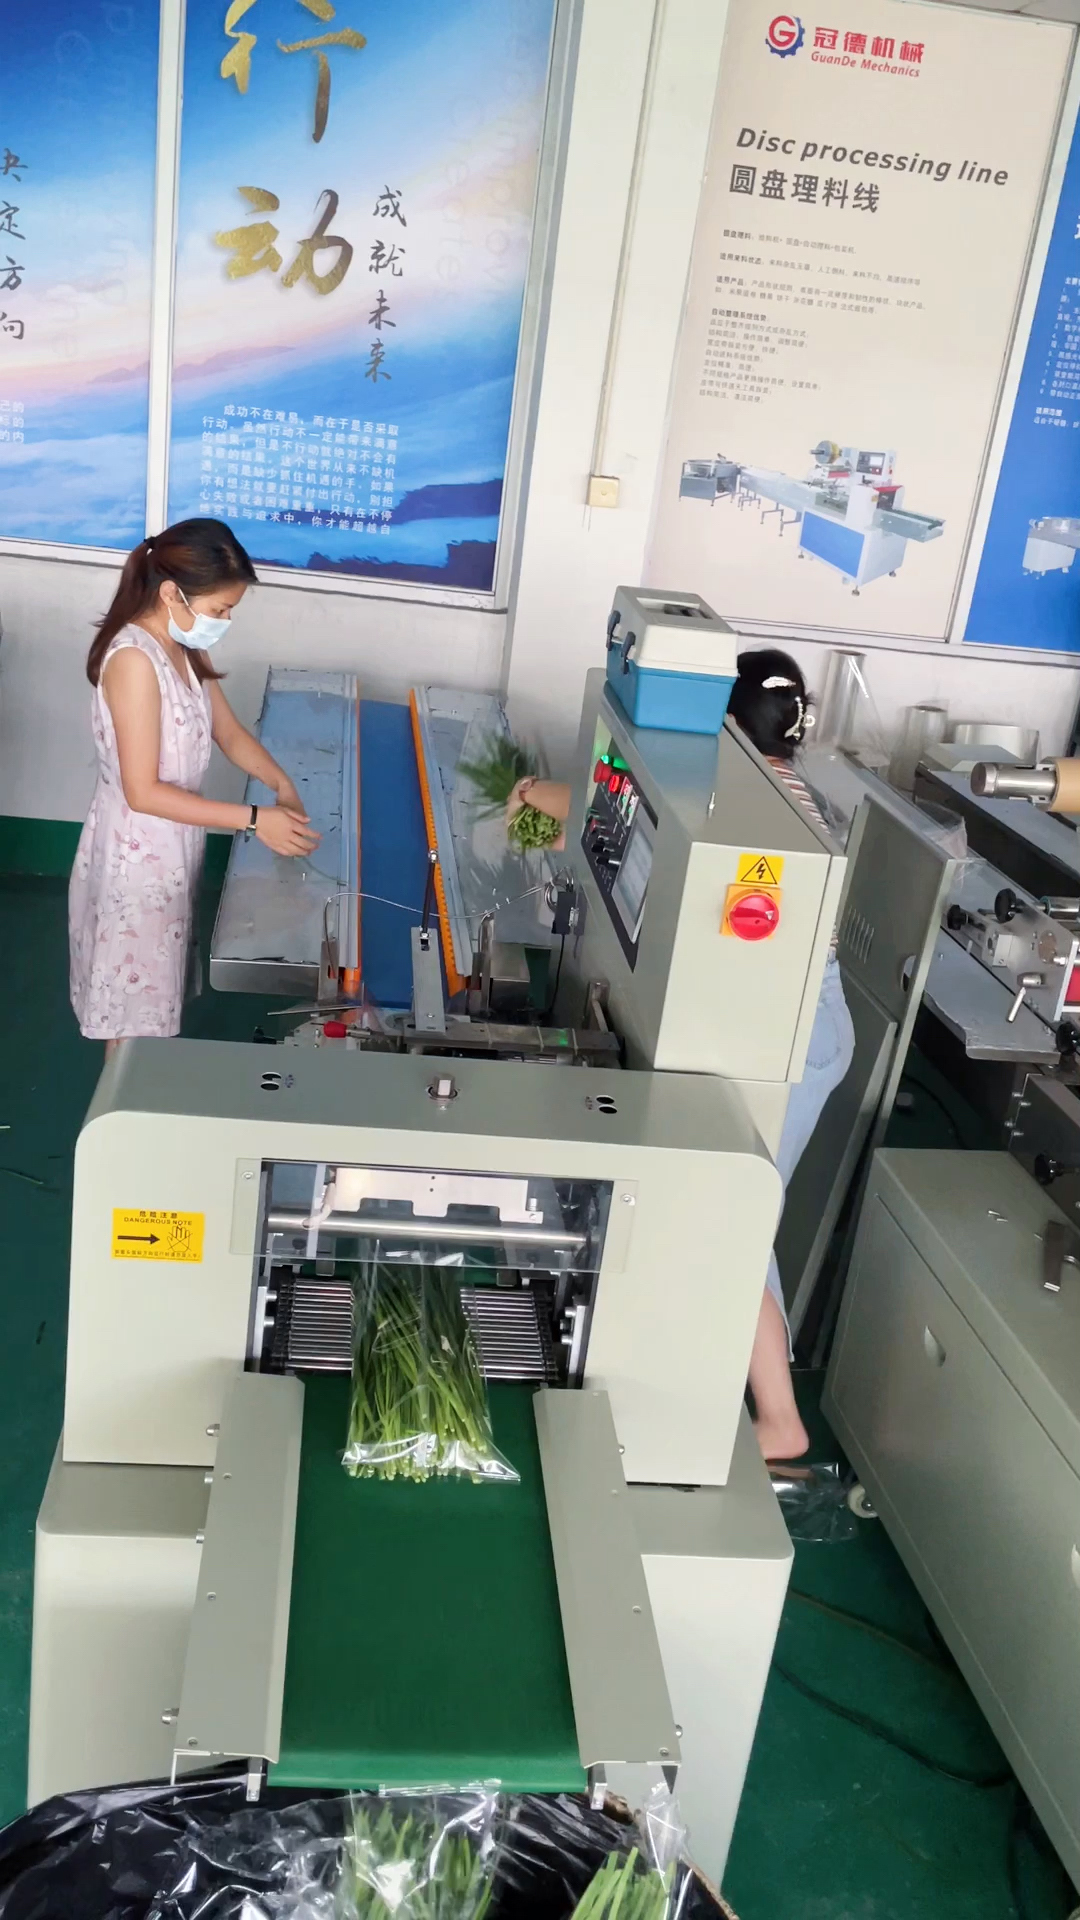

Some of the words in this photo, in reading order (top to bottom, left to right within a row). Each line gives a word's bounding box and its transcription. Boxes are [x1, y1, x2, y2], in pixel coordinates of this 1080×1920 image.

[810, 51, 857, 69] GuanDe
[860, 58, 921, 78] Mechanics
[812, 26, 925, 64] 冠德机械
[736, 127, 796, 155] Disc
[800, 140, 952, 182] processing
[957, 160, 1009, 187] line
[729, 163, 881, 213] 圆盘理料线
[364, 184, 407, 384] 成就未来
[123, 1216, 171, 1225] DANGEROUS
